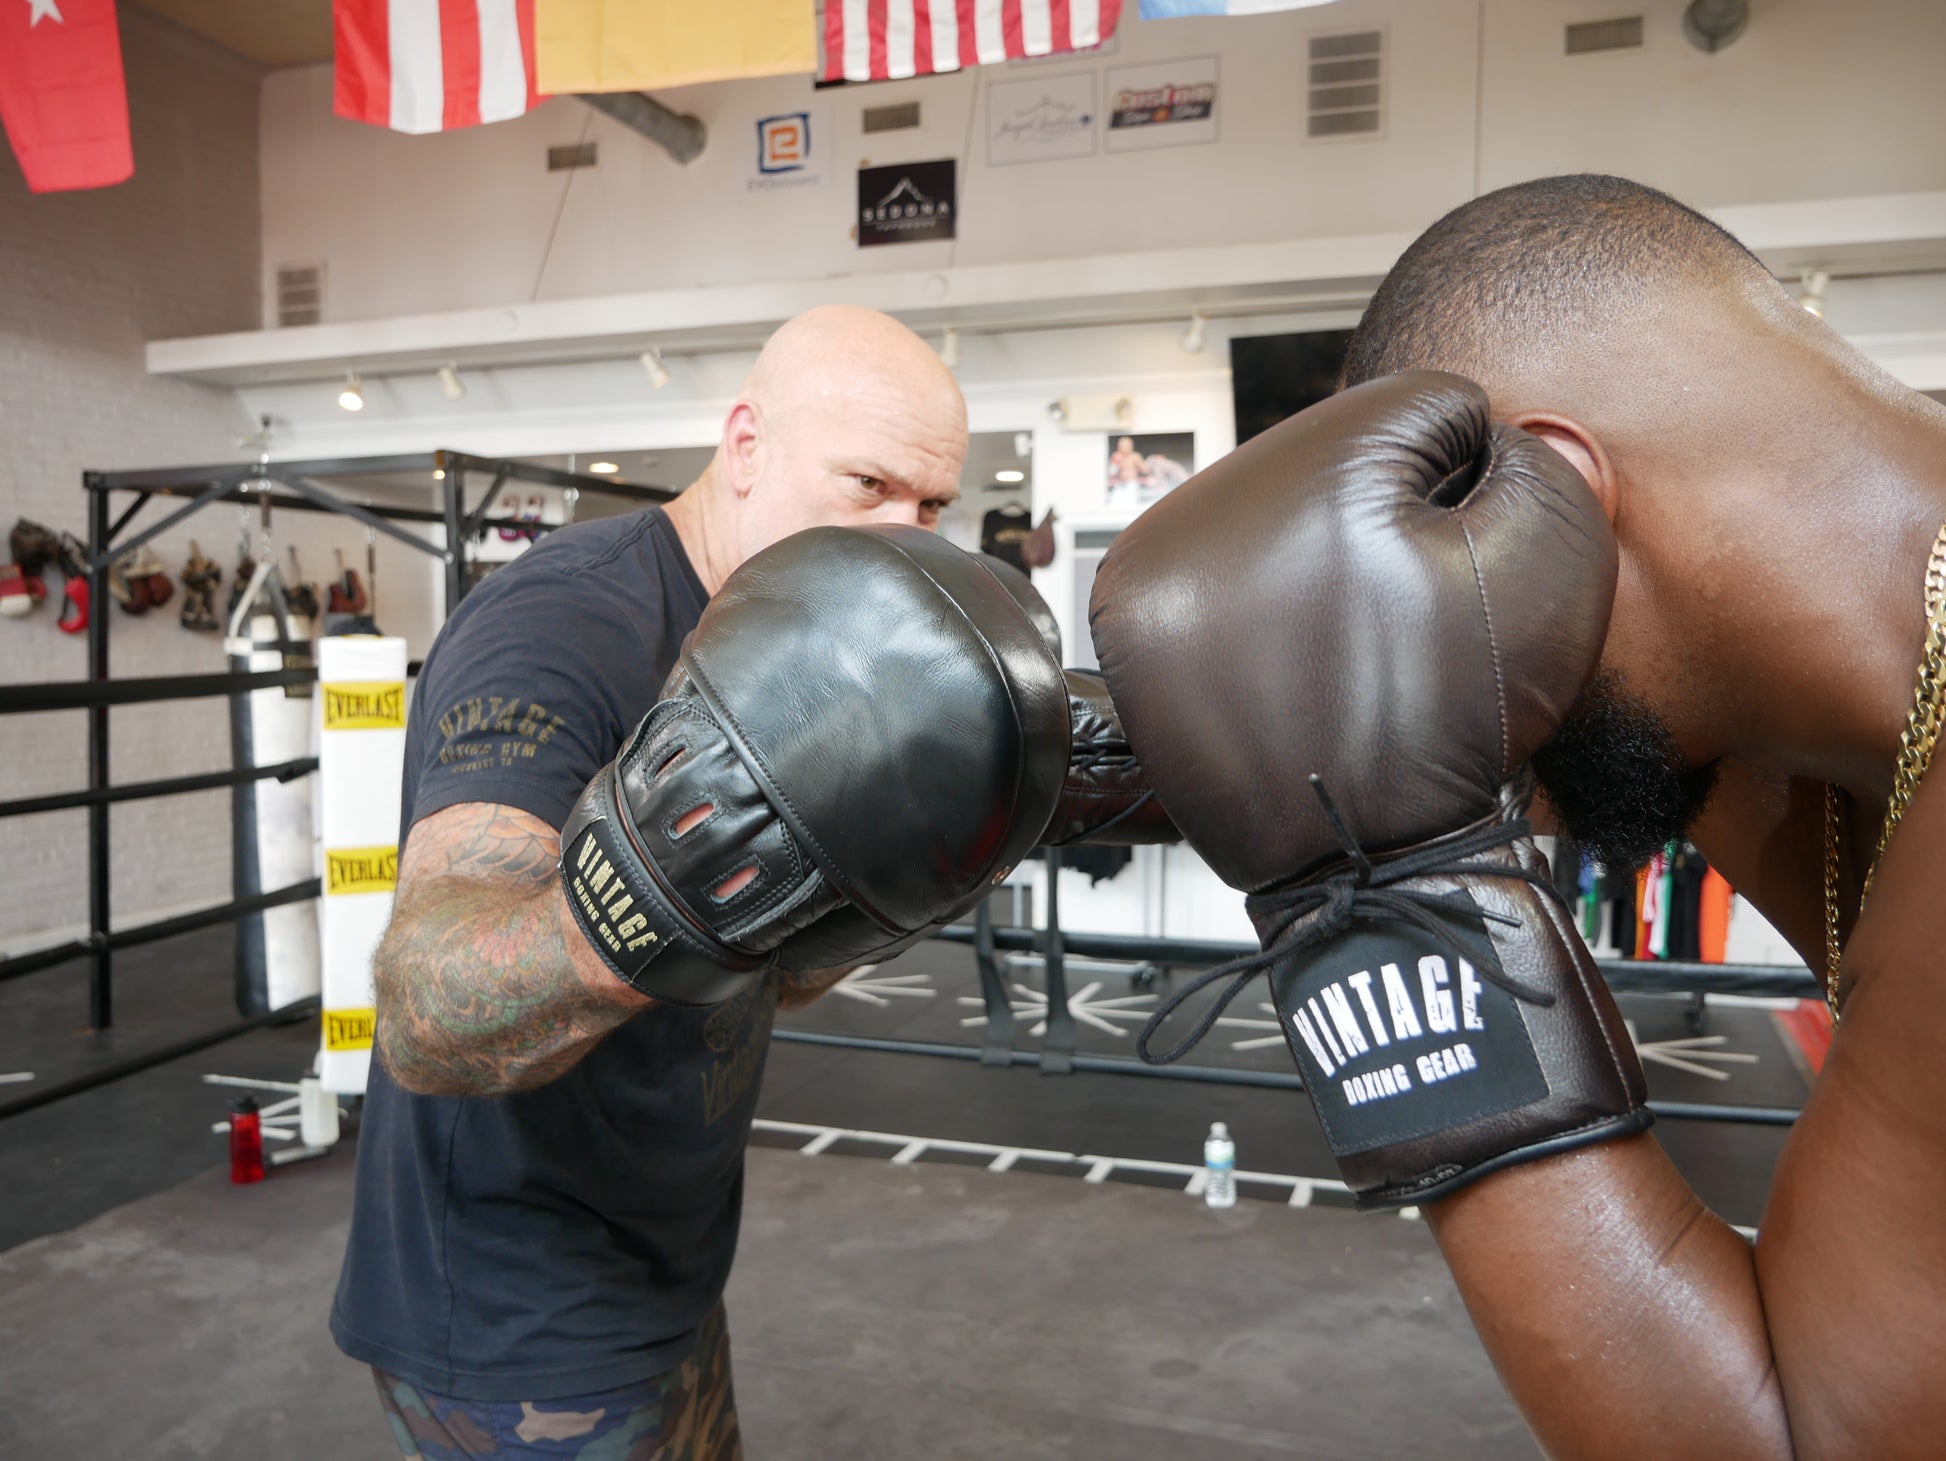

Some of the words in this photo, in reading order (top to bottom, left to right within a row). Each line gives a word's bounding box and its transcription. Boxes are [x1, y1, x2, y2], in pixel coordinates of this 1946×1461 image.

[862, 200, 950, 223] SEDONA
[326, 687, 404, 724] EVERLAST
[438, 695, 566, 744] VINTAGE
[501, 742, 537, 758] GYM
[329, 852, 398, 889] EVERLAS
[577, 832, 658, 952] VINTAGE
[573, 876, 600, 923] BOXING
[598, 922, 622, 954] GEAR
[329, 1013, 375, 1046] EVERL
[1292, 953, 1484, 1079] VINTAGE
[1342, 1063, 1413, 1107] BOXING
[1416, 1043, 1478, 1085] GEAR
